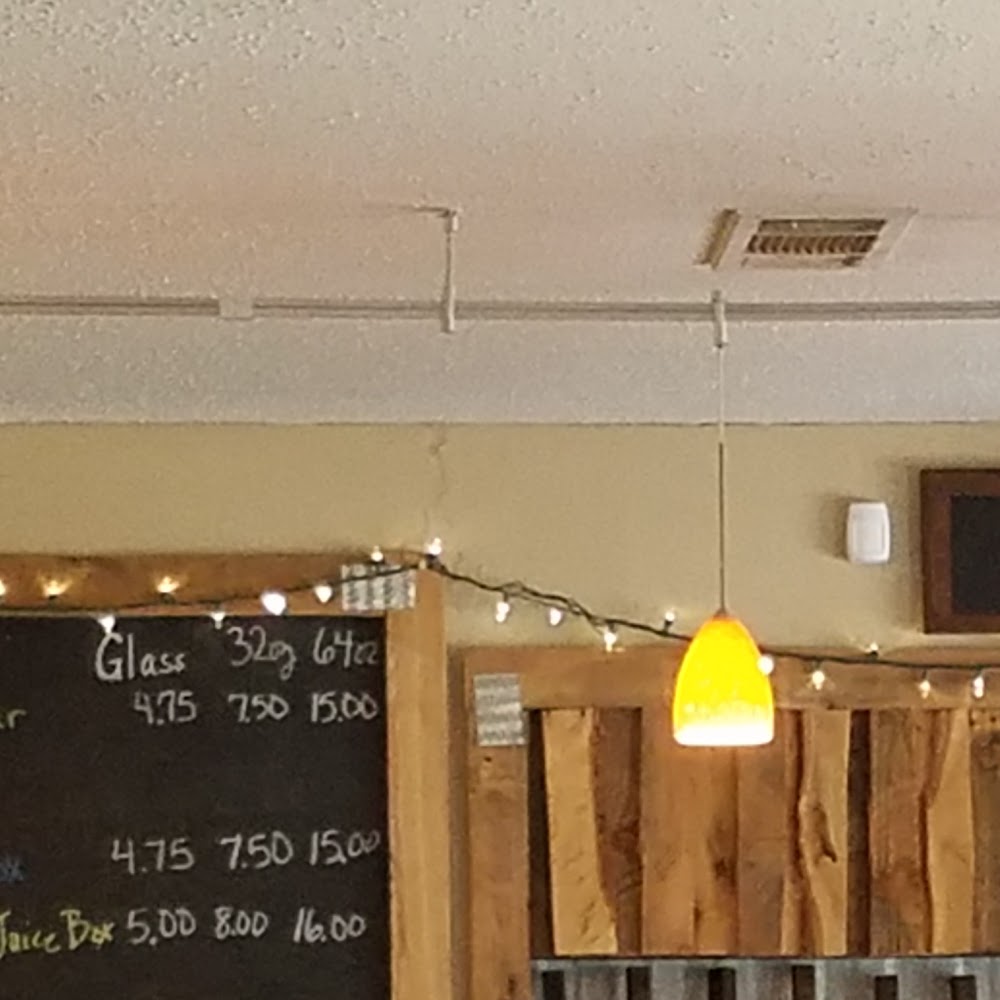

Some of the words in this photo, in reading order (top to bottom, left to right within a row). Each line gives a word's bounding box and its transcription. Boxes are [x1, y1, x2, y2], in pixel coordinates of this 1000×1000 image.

[95, 632, 186, 681] Glass
[134, 690, 197, 725] 4.75
[228, 693, 289, 723] 7.50
[311, 692, 378, 723] 15.00
[111, 838, 195, 874] 4.75
[220, 830, 294, 870] 7.50
[308, 829, 381, 866] 15.00
[126, 908, 197, 946] 5.00
[214, 909, 269, 942] 8.00
[293, 906, 367, 943] 16.00
